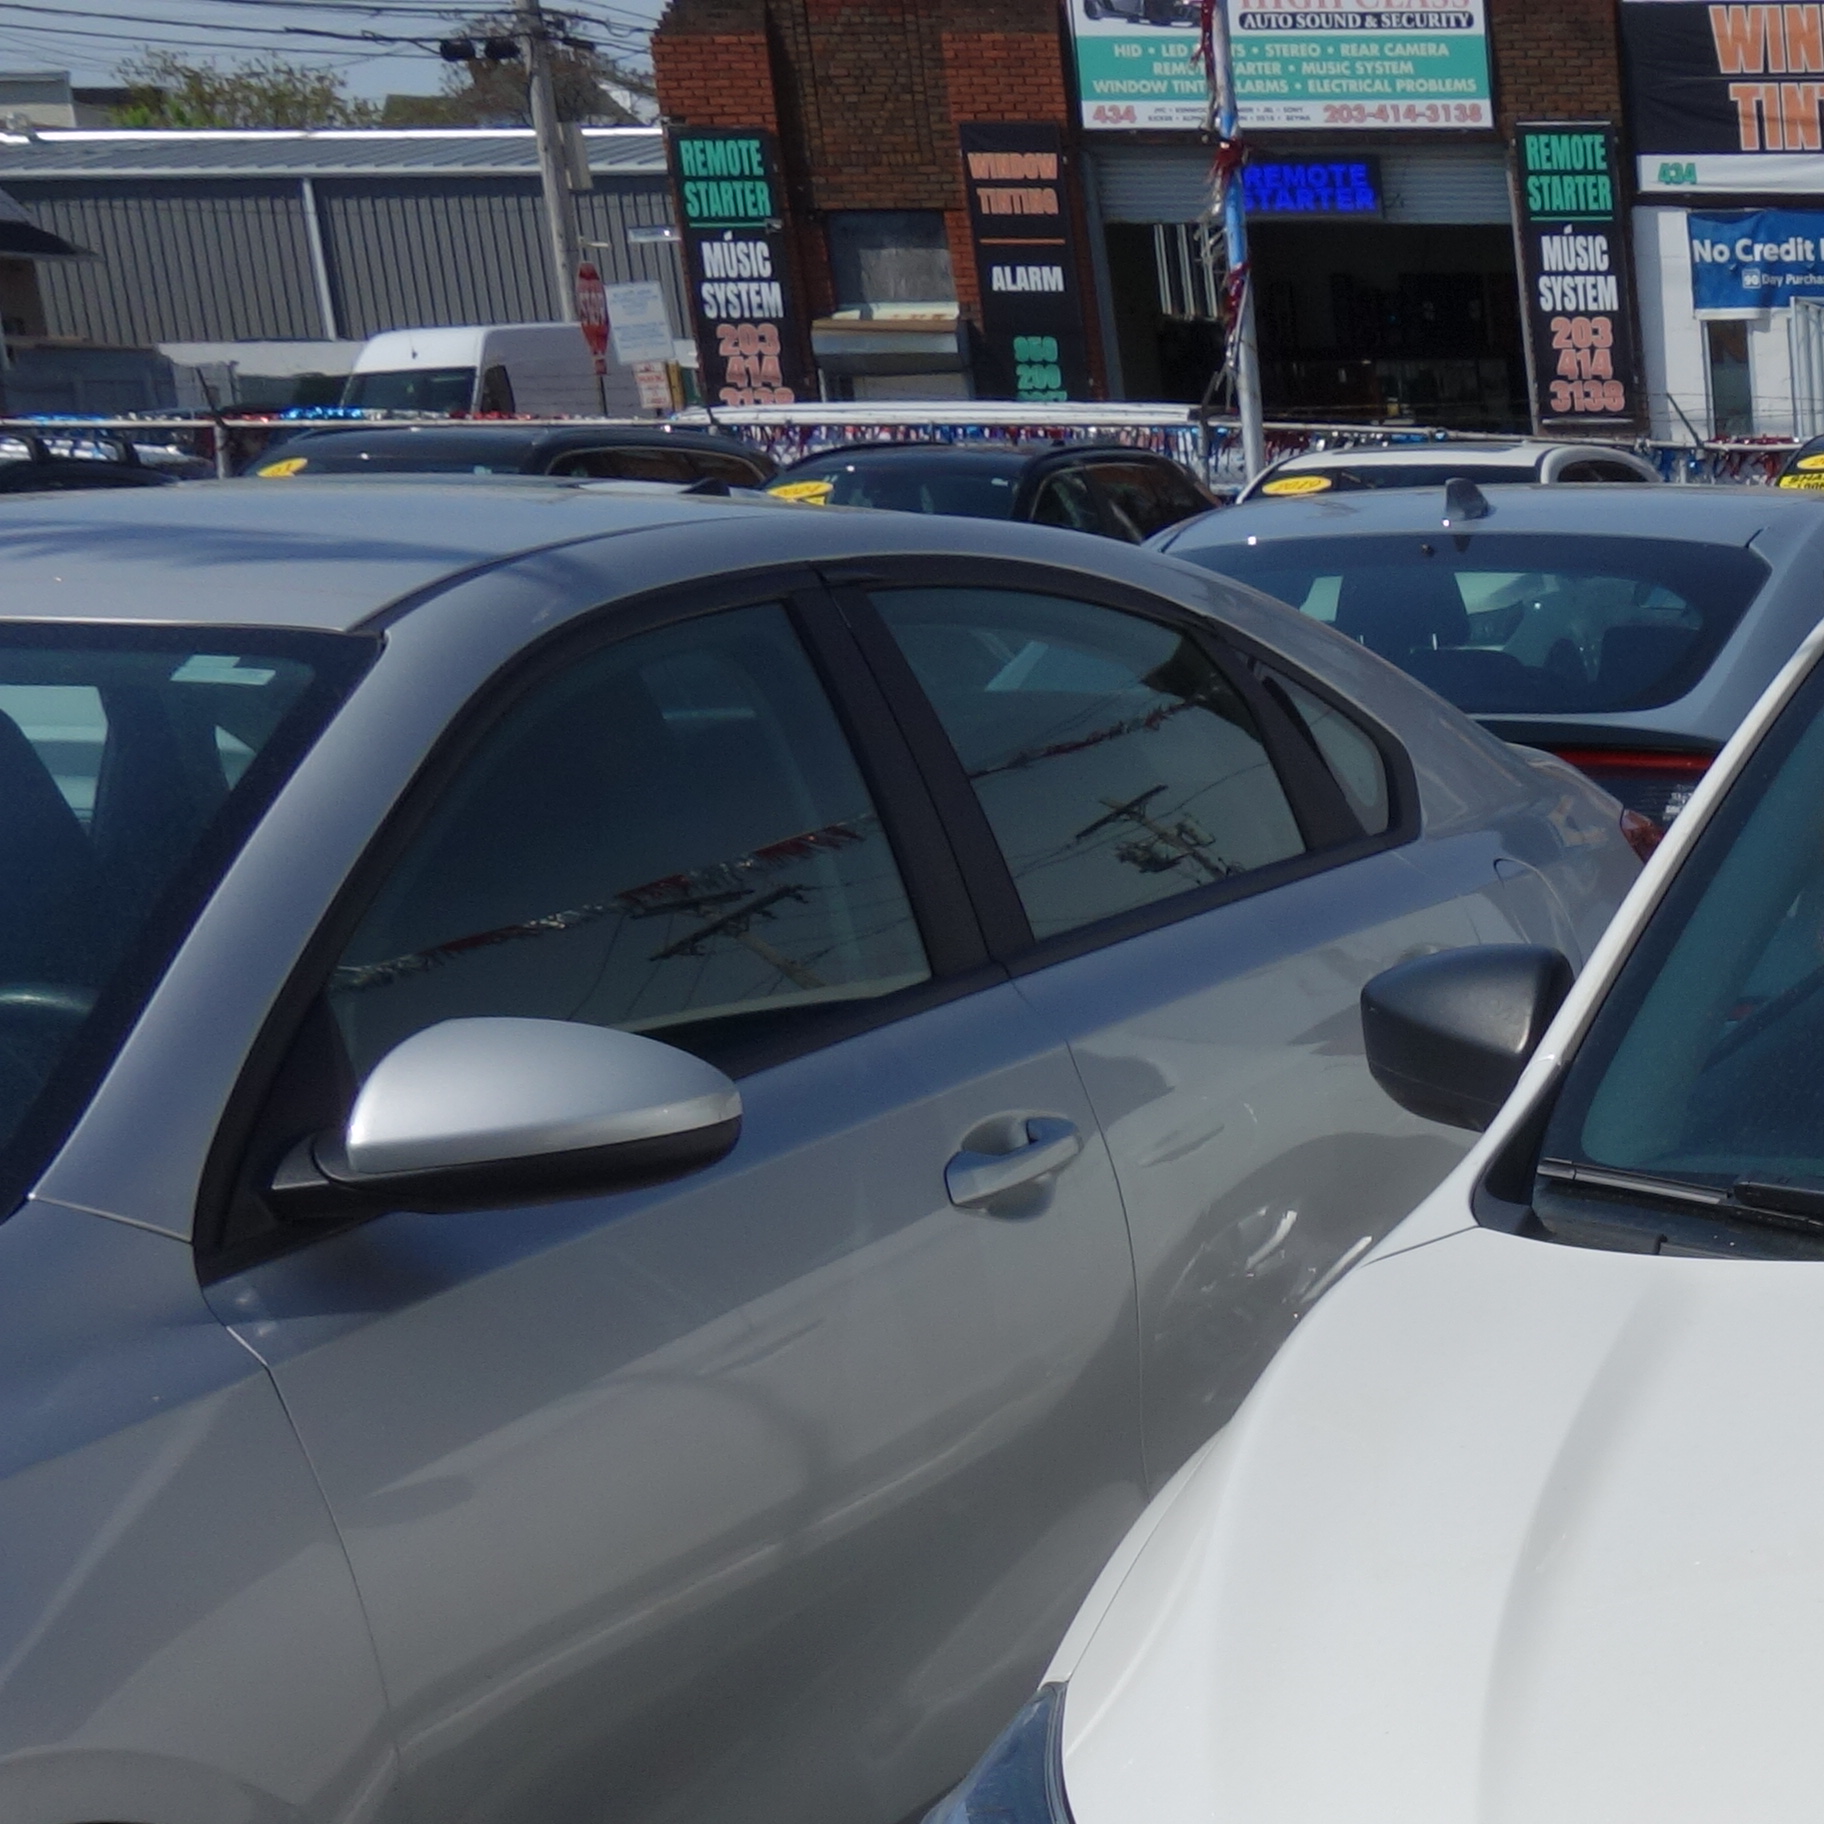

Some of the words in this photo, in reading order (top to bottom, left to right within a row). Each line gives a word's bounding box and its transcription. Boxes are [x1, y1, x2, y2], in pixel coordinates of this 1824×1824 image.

[1243, 13, 1292, 29] AUTO
[1296, 13, 1361, 29] SOUND
[1364, 14, 1377, 28] &
[1381, 12, 1470, 28] SECURITY
[1114, 43, 1142, 58] HID
[1161, 43, 1188, 58] LED
[1265, 43, 1320, 58] STEREO
[1340, 43, 1380, 57] REAR
[1384, 43, 1449, 57] CAMERA
[1302, 61, 1350, 75] MUSIC
[1355, 61, 1414, 75] SYSTEM
[1093, 80, 1168, 94] WINDOW
[1237, 80, 1288, 94] LARMS
[1308, 79, 1391, 93] ELECTRICAL
[1396, 79, 1477, 93] PROBLEMS
[1093, 104, 1137, 124] 434
[1323, 103, 1483, 124] 203-414-3138
[680, 139, 765, 176] REMOTE
[1525, 134, 1608, 171] REMOTE
[967, 153, 1058, 179] WINDOW
[1243, 164, 1367, 189] REMOTE
[1657, 161, 1697, 185] 434
[684, 180, 772, 217] STARTER
[976, 187, 1059, 215] TINTING
[1244, 187, 1377, 211] STARTER
[1527, 175, 1613, 211] STARTER
[1692, 238, 1730, 263] No
[1735, 236, 1815, 262] Credit
[992, 265, 1065, 292] ALARM
[1762, 274, 1783, 287] Day
[701, 282, 784, 318] SYSTEM
[1539, 276, 1619, 312] SYSTEM
[716, 323, 781, 356] 203
[1551, 316, 1613, 349] 203
[726, 356, 783, 388] 414
[1557, 349, 1613, 380] 414
[1550, 380, 1625, 412] 3138
